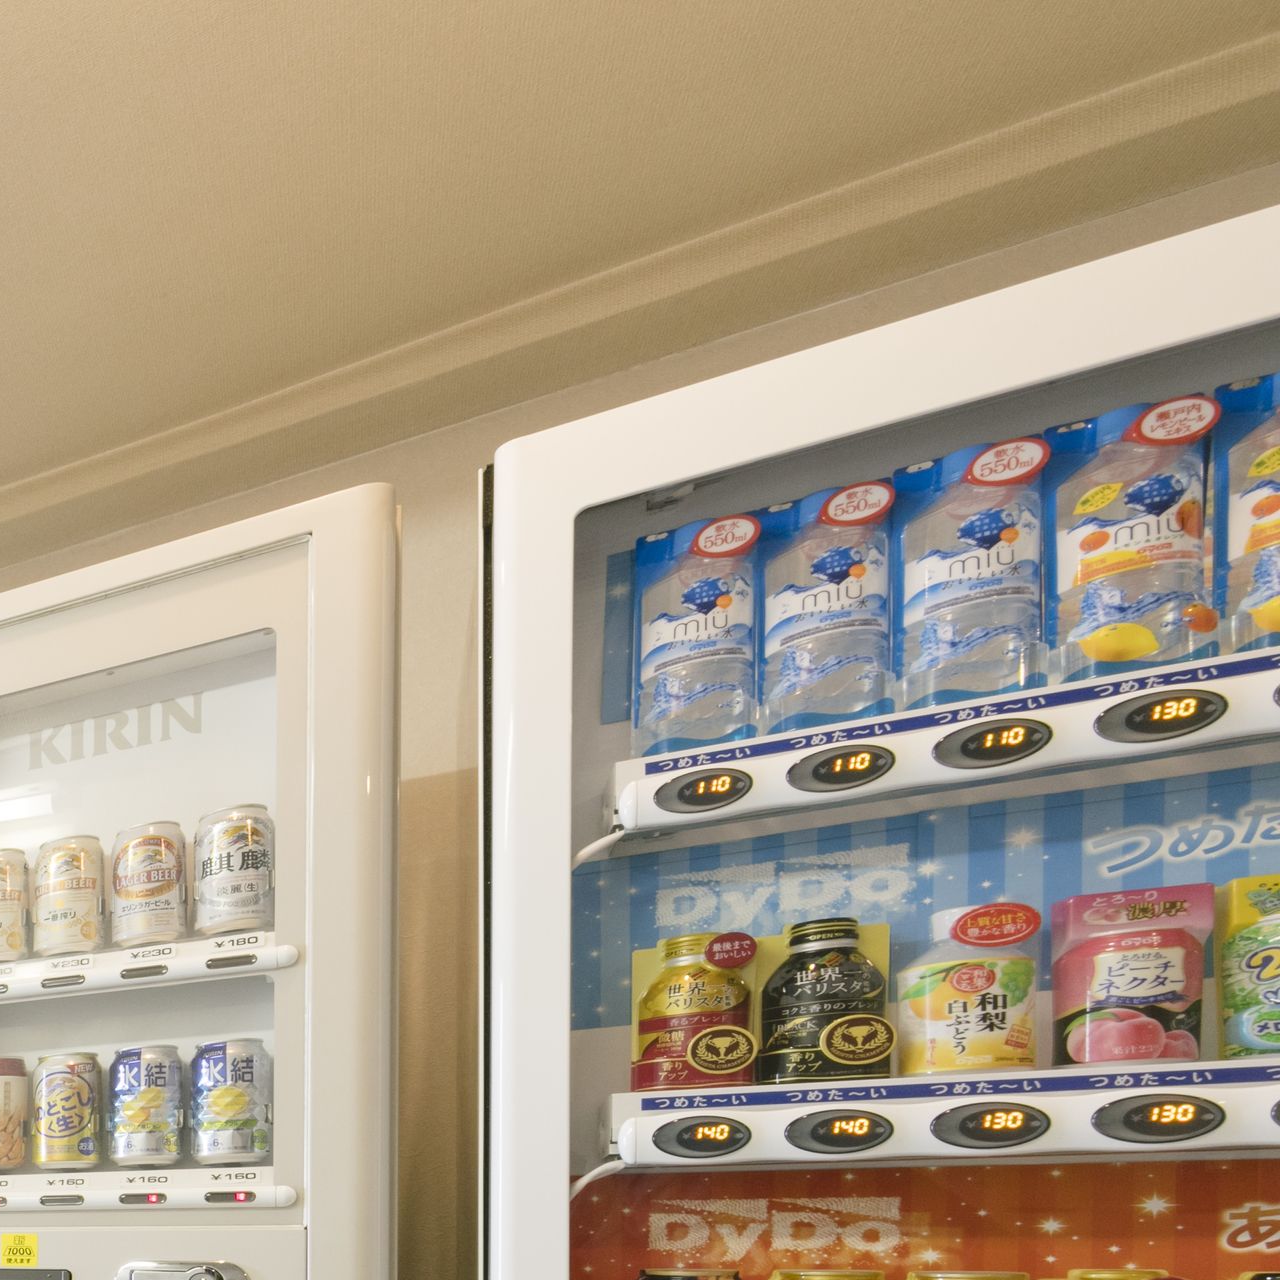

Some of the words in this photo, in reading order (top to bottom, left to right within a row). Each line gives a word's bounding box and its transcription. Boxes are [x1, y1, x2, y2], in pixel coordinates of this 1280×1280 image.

[980, 455, 1033, 478] 550ml
[834, 498, 881, 517] 550ml
[703, 531, 747, 549] 550ml
[26, 690, 206, 771] KIRIN
[201, 848, 271, 880] 麒麟
[116, 872, 150, 890] LAGER
[151, 868, 177, 882] BEER
[655, 860, 915, 930] DyDo
[44, 910, 77, 922] 一番搾り
[1126, 900, 1188, 921] 濃厚
[215, 936, 259, 948] ¥180
[712, 940, 751, 953] 最後まで
[130, 947, 172, 959] ¥230
[714, 950, 751, 961] おいしい
[51, 958, 90, 969] ¥230
[1106, 960, 1176, 977] ピーチ
[794, 966, 863, 985] 世界一
[793, 980, 863, 997] バリスタ
[1096, 975, 1185, 994] ネクター
[665, 995, 724, 1010] バリスタ
[782, 1001, 879, 1016] コクと香りのブレンド
[974, 992, 1009, 1032] 和梨
[946, 1000, 971, 1056] 白ぶどう
[790, 1052, 815, 1062] 香り
[74, 1063, 94, 1074] NEW
[198, 1057, 255, 1087] 氷結
[662, 1061, 682, 1071] 香り
[786, 1060, 823, 1073] アップ
[115, 1063, 168, 1091] 氷結
[658, 1070, 689, 1081] アップ
[47, 1178, 85, 1187] ¥160
[126, 1175, 169, 1184] ¥160
[211, 1172, 257, 1181] ¥160
[648, 1204, 901, 1262] DyDo
[7, 1247, 32, 1256] 1000
